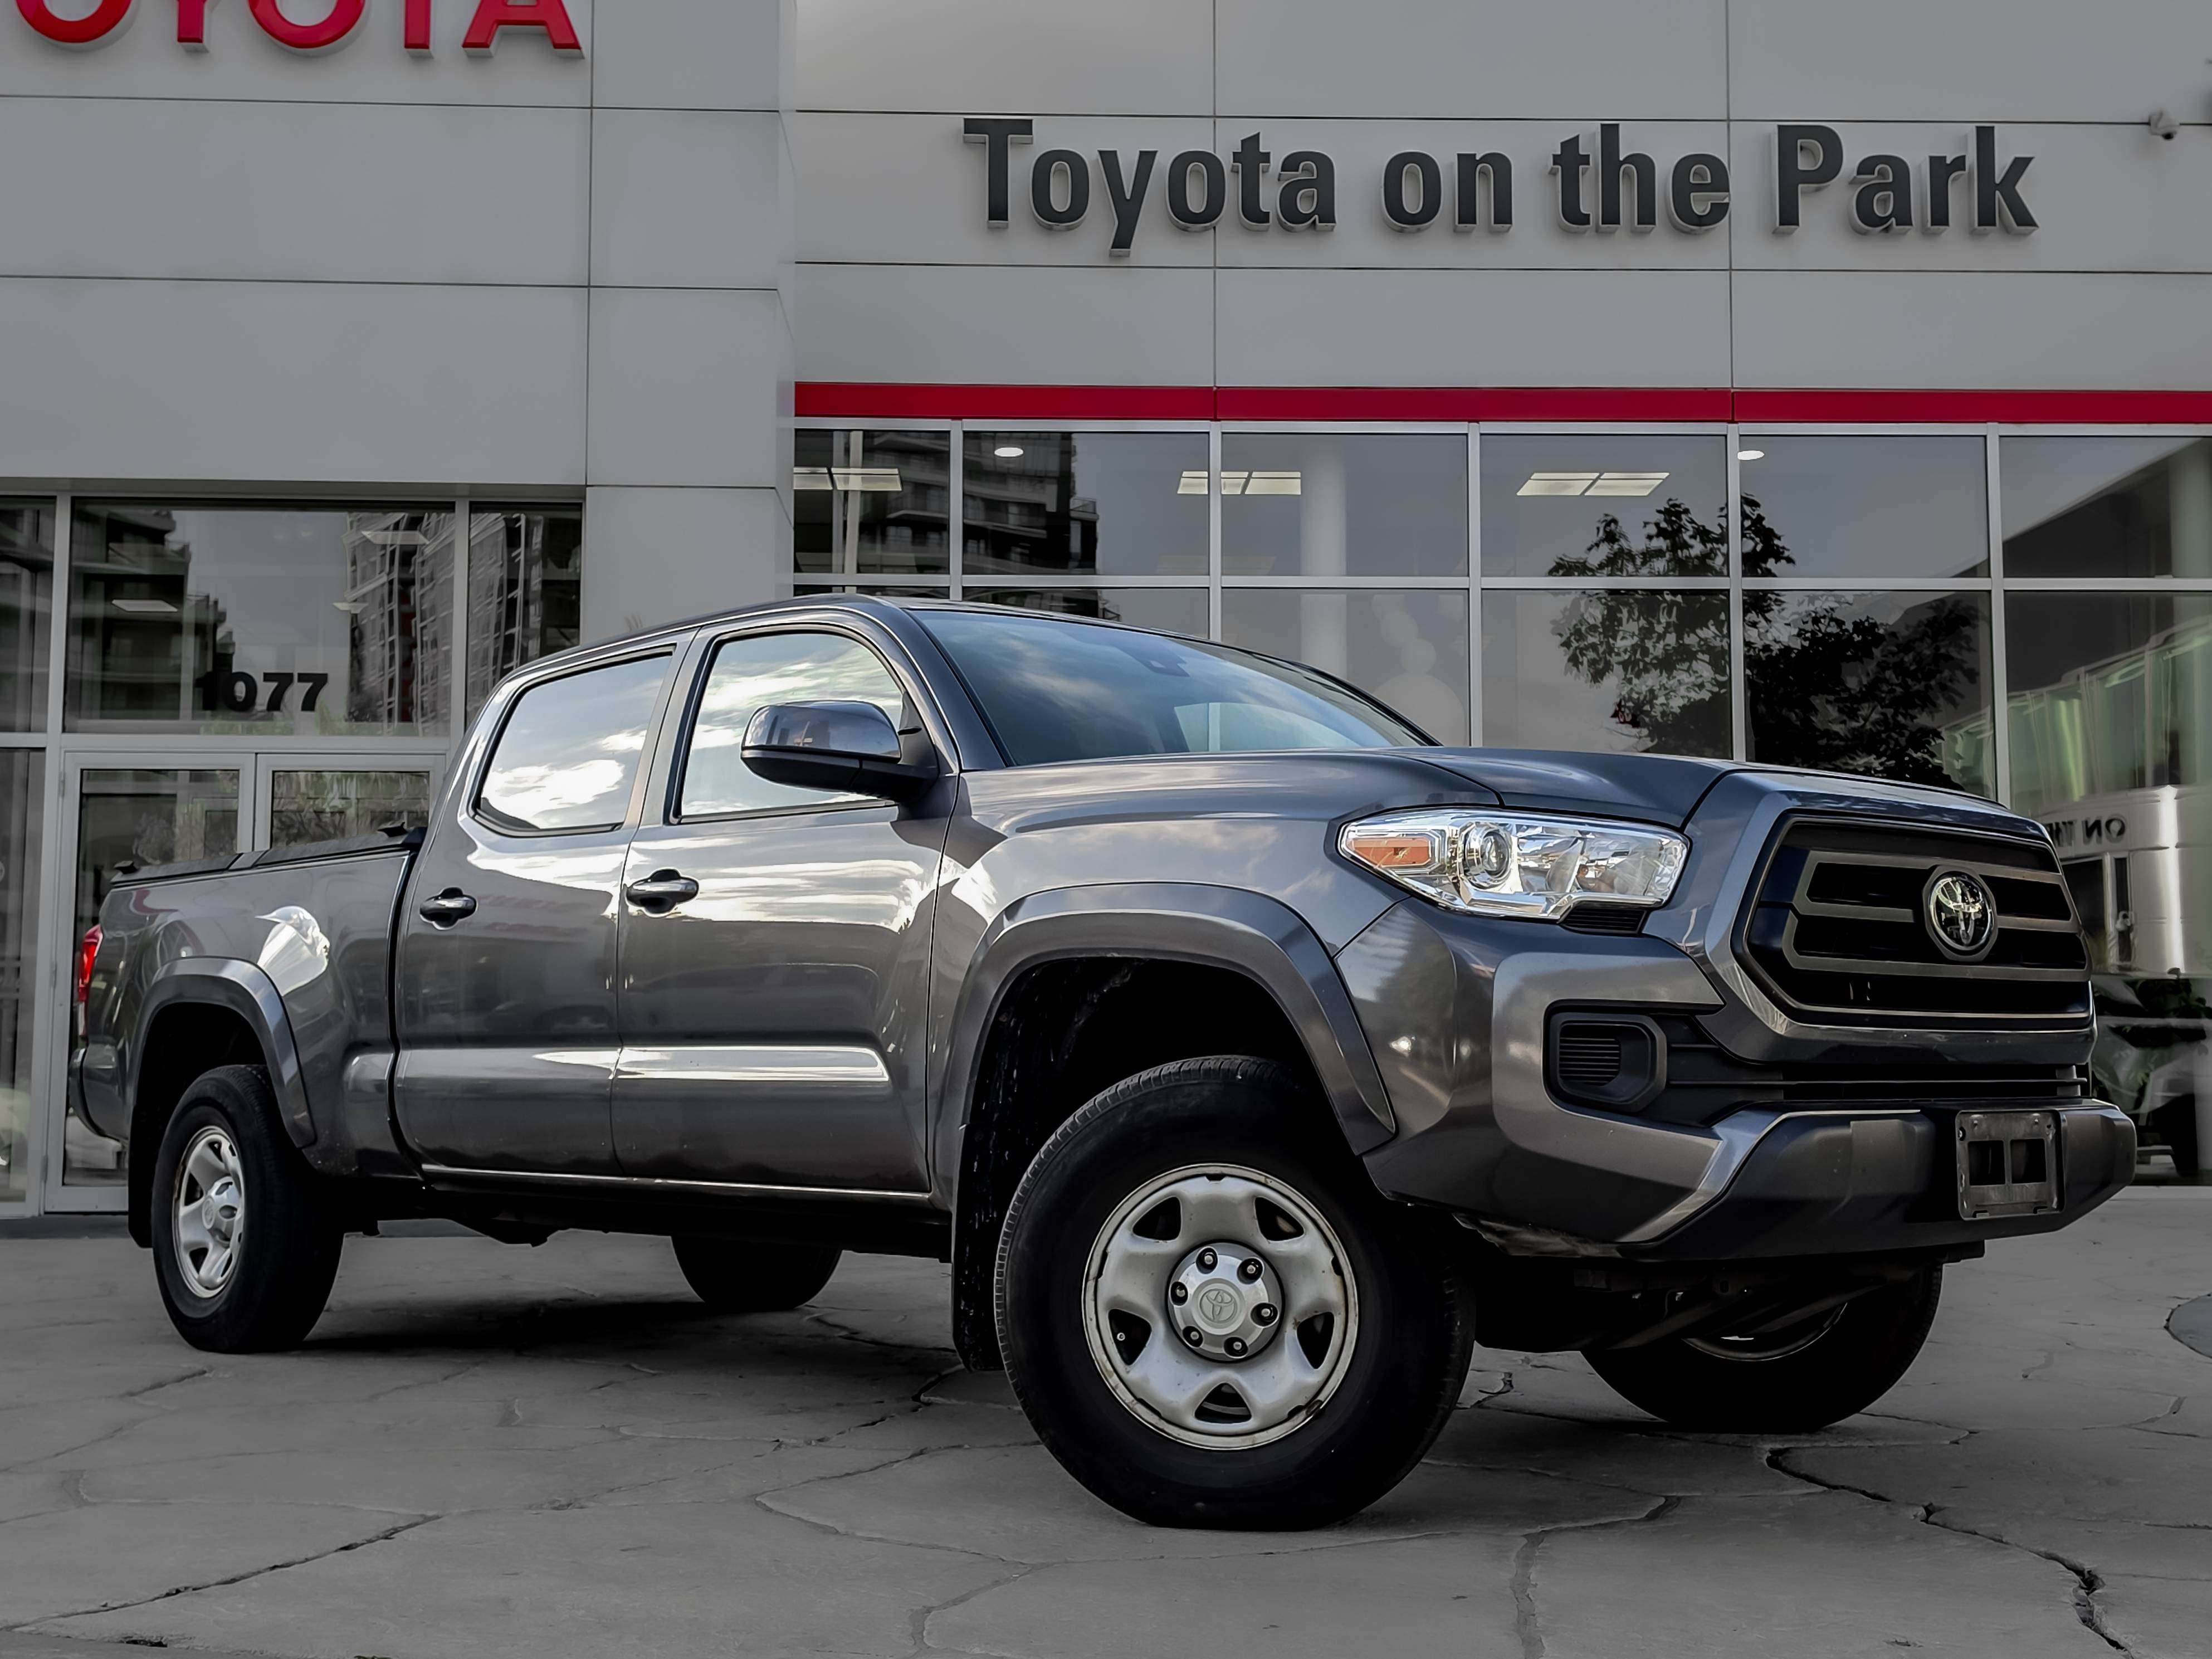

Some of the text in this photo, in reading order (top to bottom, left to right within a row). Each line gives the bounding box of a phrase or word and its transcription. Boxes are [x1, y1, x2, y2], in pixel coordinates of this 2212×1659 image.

[963, 118, 2038, 255] Toyota on the Park
[195, 671, 328, 711] 1077
